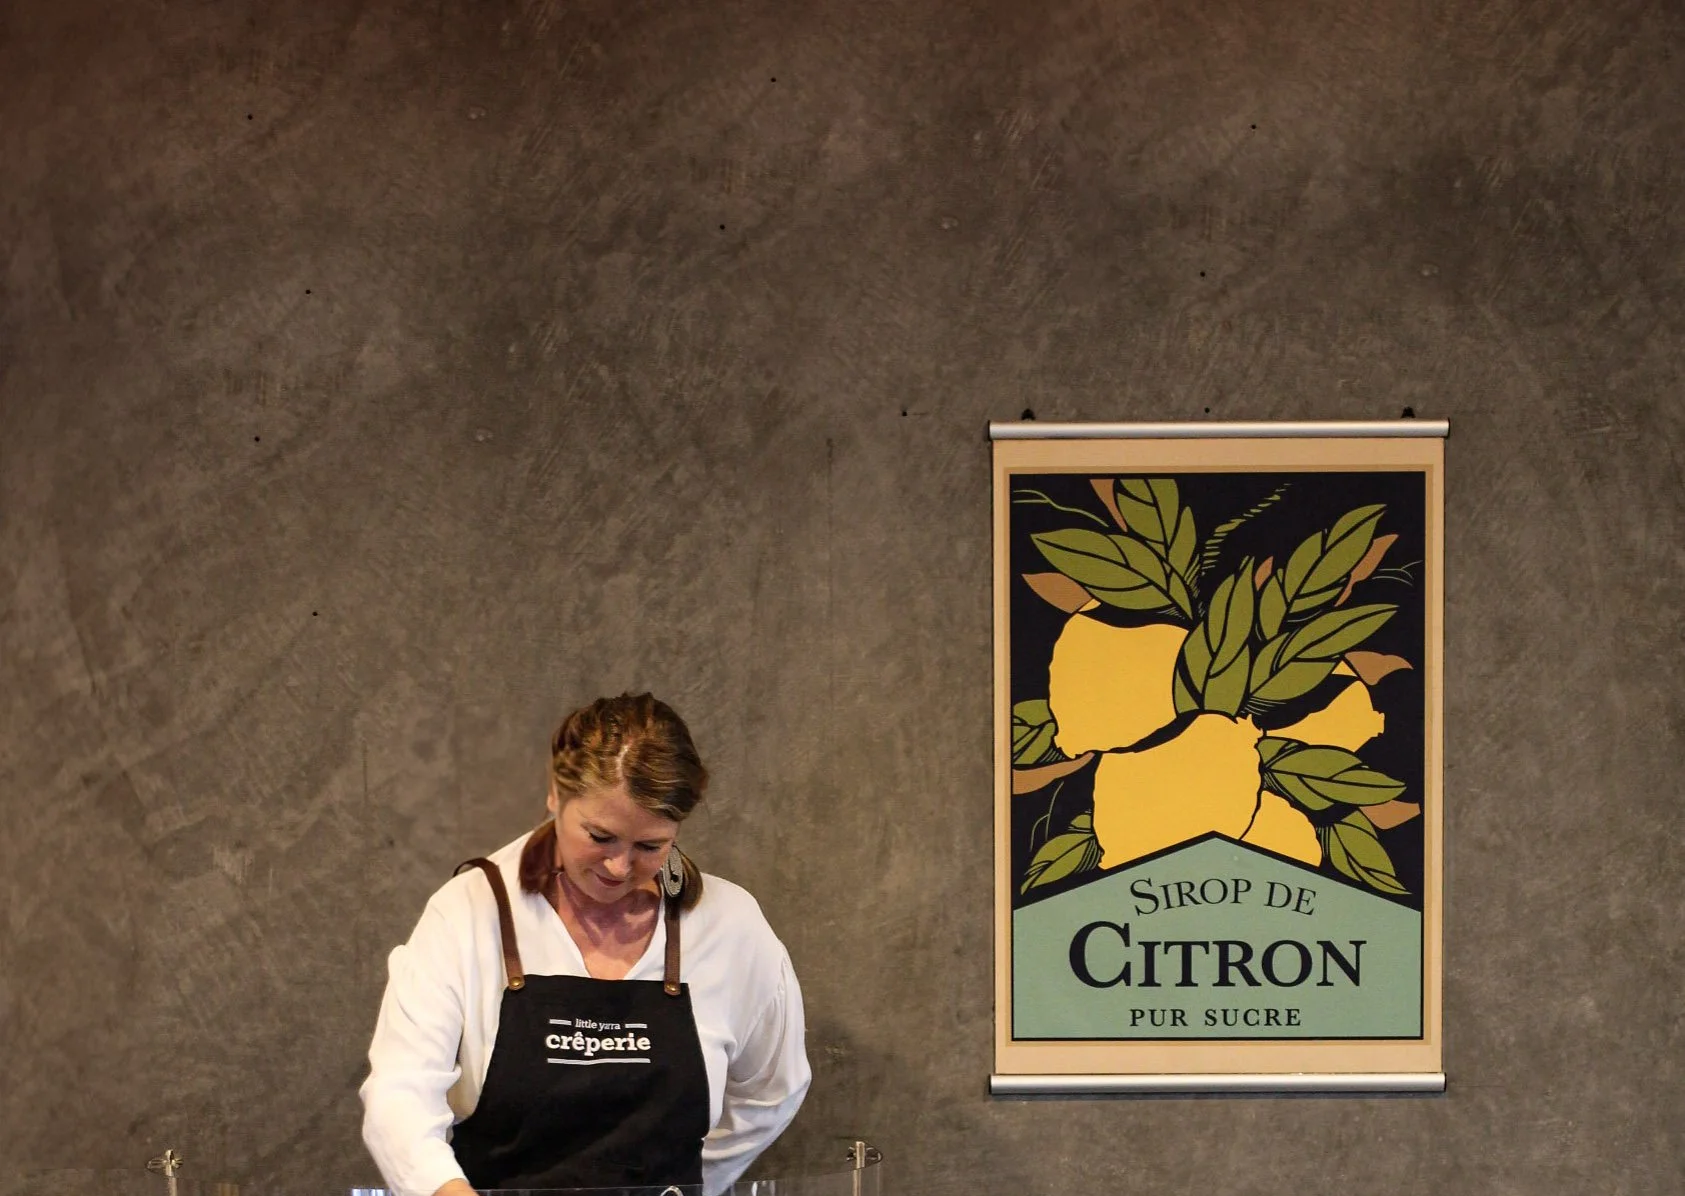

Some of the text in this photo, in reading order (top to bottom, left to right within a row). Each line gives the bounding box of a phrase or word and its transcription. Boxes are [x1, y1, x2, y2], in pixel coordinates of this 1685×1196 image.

[1130, 878, 1316, 916] SIROP DE
[1069, 921, 1366, 988] CITRON
[574, 1018, 621, 1032] little yarra
[1130, 1009, 1300, 1026] PUR SUCRE
[546, 1031, 651, 1056] crêperie
